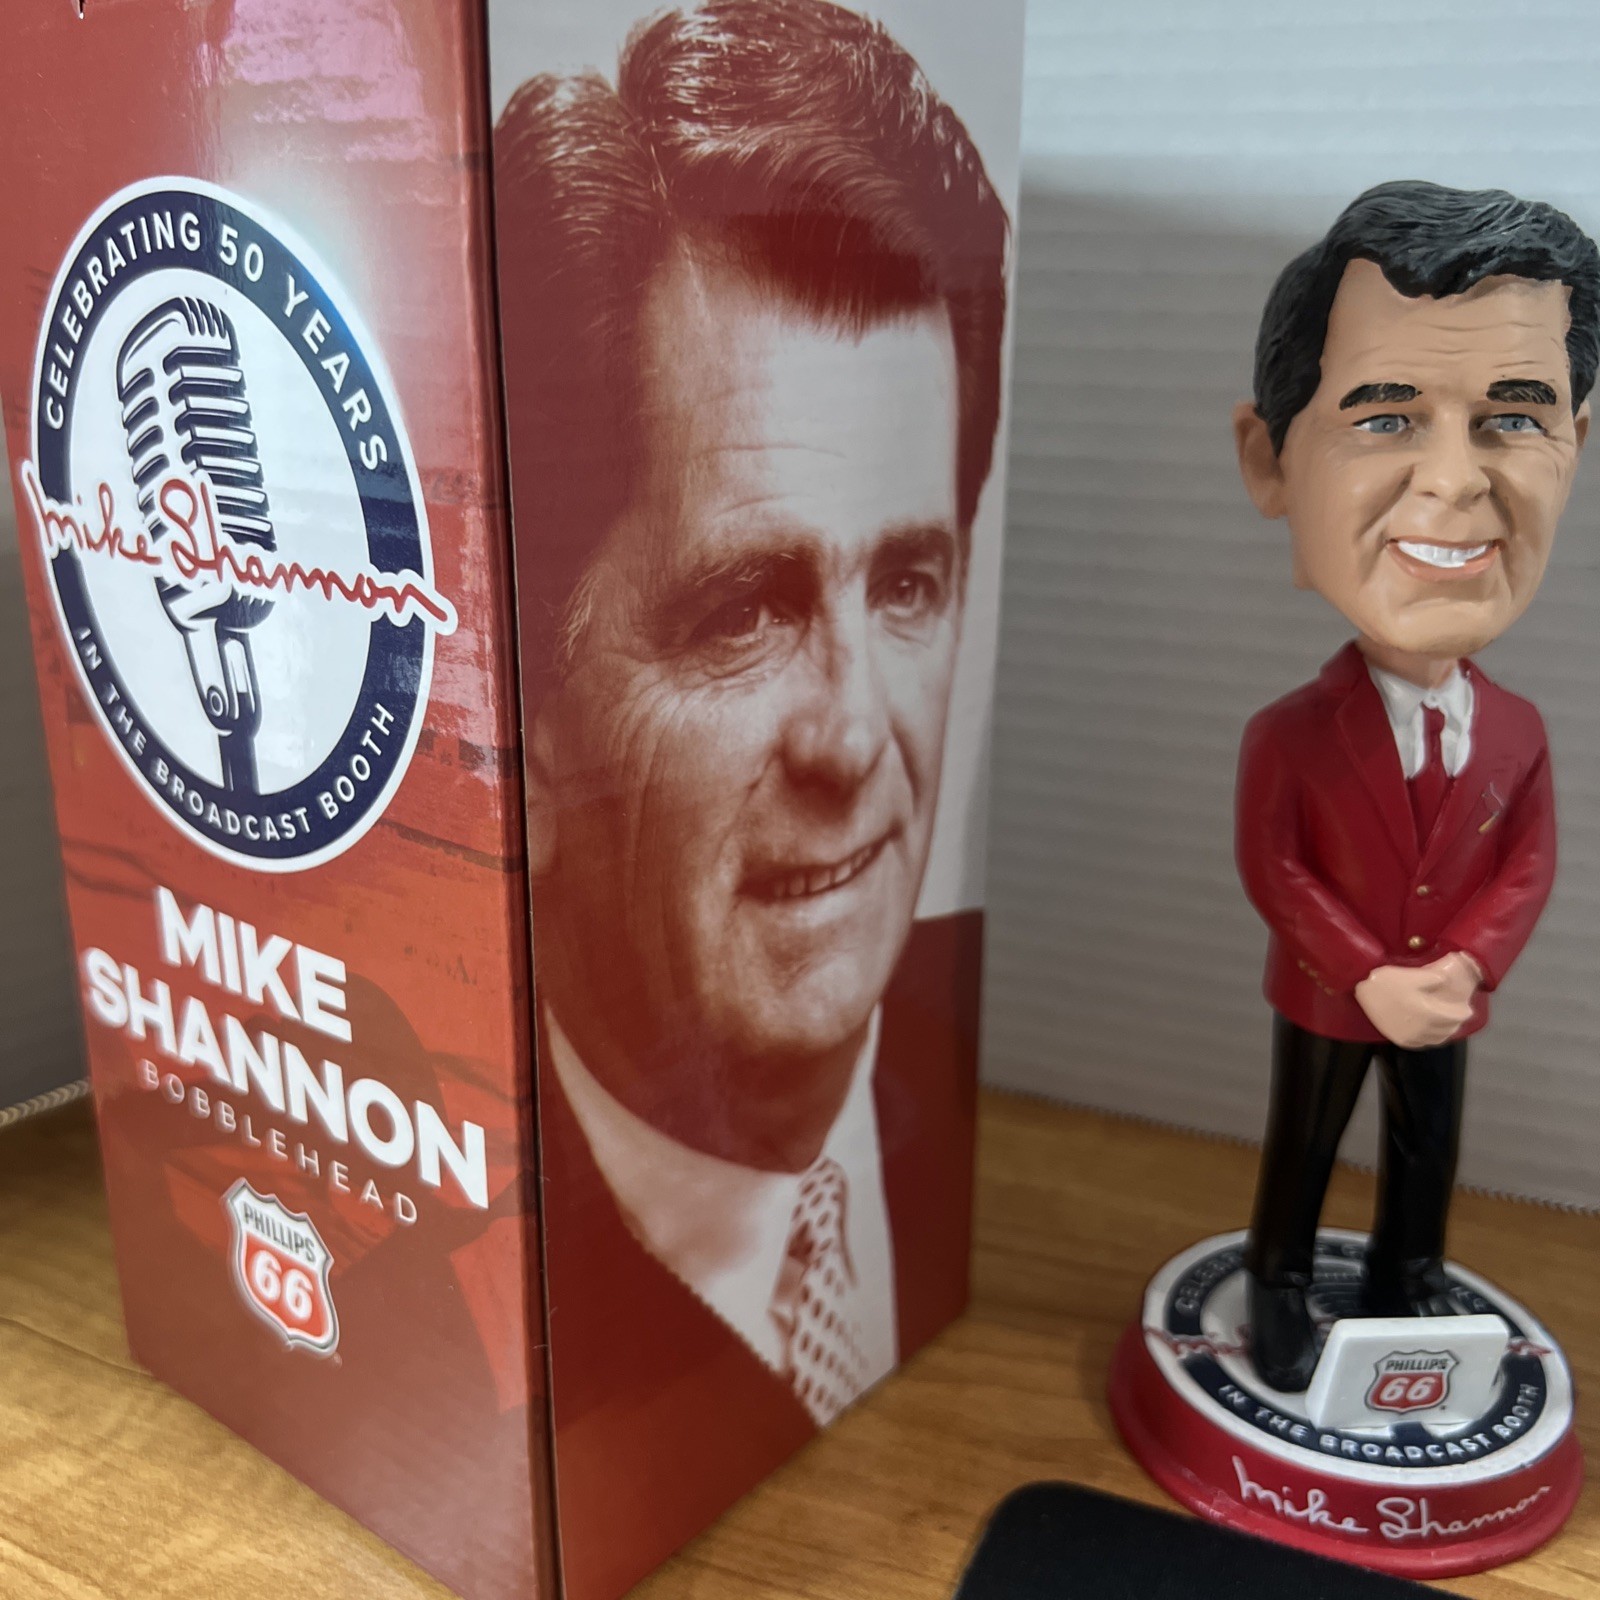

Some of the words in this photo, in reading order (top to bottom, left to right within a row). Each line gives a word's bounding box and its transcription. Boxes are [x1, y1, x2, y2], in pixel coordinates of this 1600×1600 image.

[45, 210, 202, 430] CELEBRATING
[218, 223, 265, 282] 50
[284, 273, 388, 471] YEARS
[75, 627, 102, 671] IN
[104, 682, 147, 757] THE
[154, 756, 312, 842] BROADCAST
[319, 702, 395, 820] BOOTH
[155, 884, 353, 1043] MIKE
[81, 946, 489, 1209] SHANNON
[138, 1057, 418, 1225] BOBBLEHEAD
[242, 1201, 316, 1263] PHILLIPS
[253, 1249, 314, 1322] 66
[1218, 1384, 1250, 1407] IN
[1255, 1406, 1310, 1439] THE
[1319, 1433, 1493, 1461] BROADCAST
[1492, 1383, 1539, 1440] BOOTH
[1379, 1376, 1437, 1402] 66
[1384, 1358, 1449, 1371] PHILLIPS
